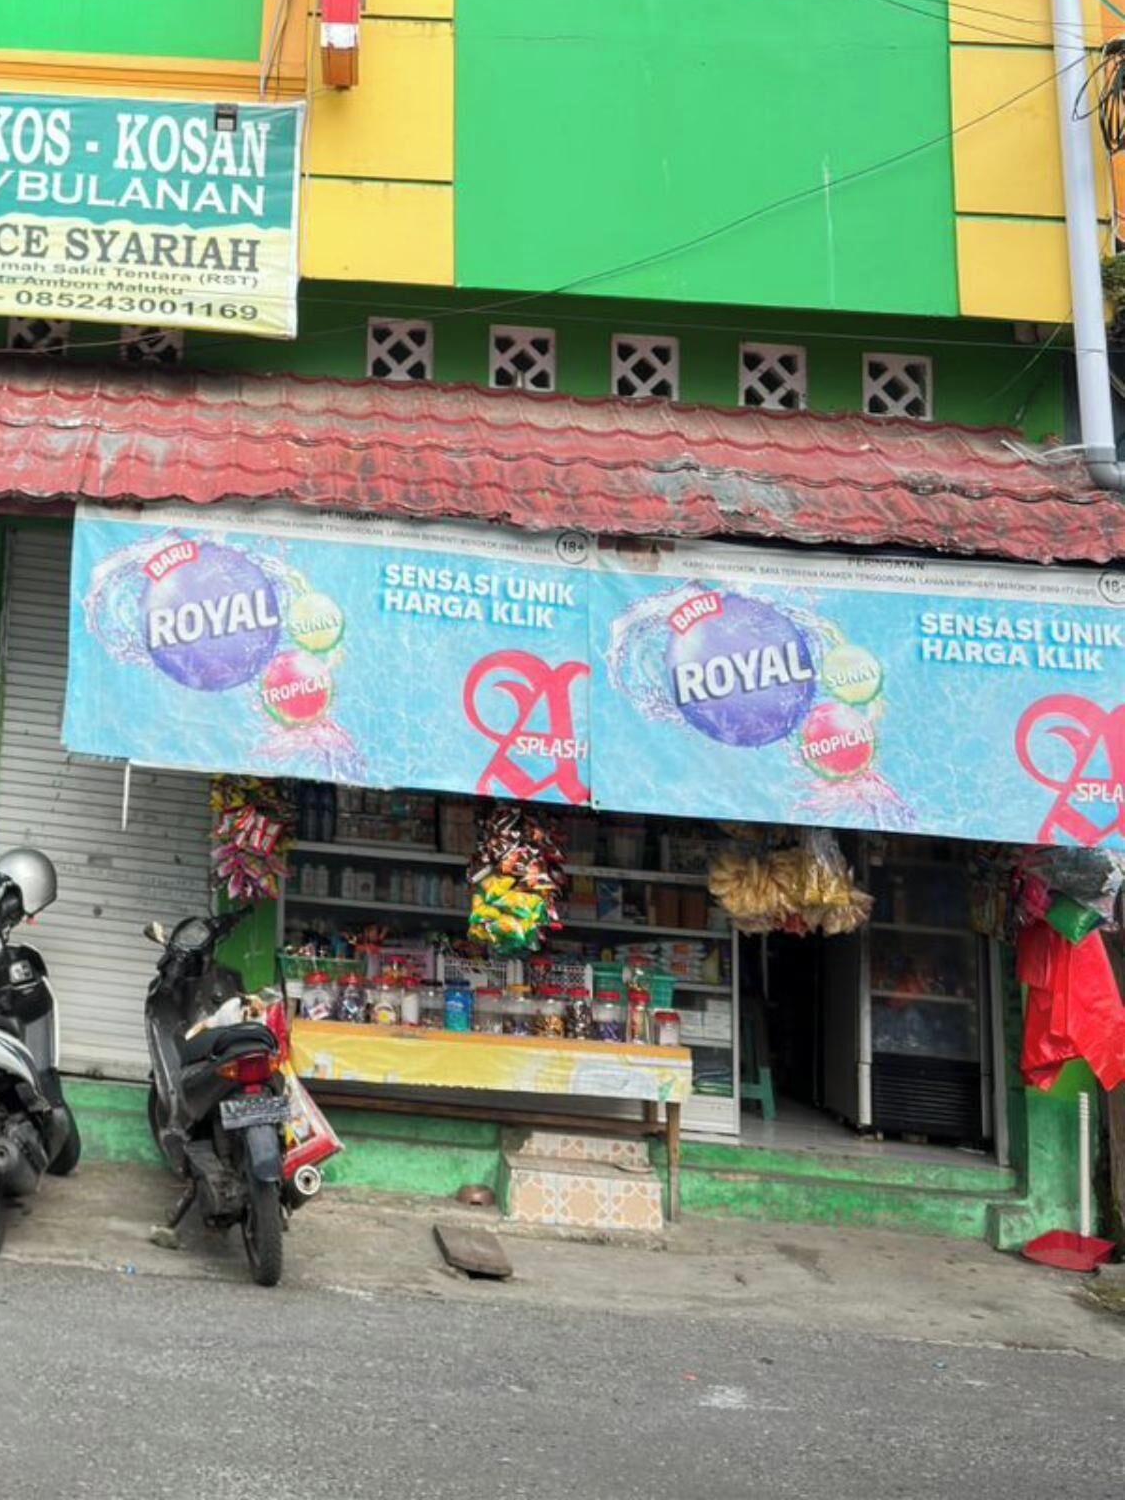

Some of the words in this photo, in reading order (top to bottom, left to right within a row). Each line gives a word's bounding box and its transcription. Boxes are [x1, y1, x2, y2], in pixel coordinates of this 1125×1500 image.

[85, 141, 99, 152] -
[113, 112, 270, 178] KOSAN
[65, 227, 262, 273] SYARIAH
[23, 274, 102, 291] Ambon
[107, 280, 185, 296] Maluku
[53, 262, 106, 277] Sakit
[112, 266, 192, 283] Tentara
[198, 273, 259, 289] (RST)
[14, 289, 259, 322] 085243001169
[148, 542, 194, 577] BARU
[562, 540, 585, 554] 18+
[385, 563, 500, 597] SENSASI
[507, 577, 576, 607] UNIK
[148, 589, 279, 649] ROYAL
[291, 613, 341, 636] SUNNY
[384, 590, 483, 622] HARGA
[492, 602, 555, 629] KLIK
[671, 596, 718, 631] BARU
[921, 612, 1042, 642] SENSASI
[1052, 620, 1125, 646] UNIK
[921, 638, 1030, 666] HARGA
[1039, 646, 1104, 671] KLIK
[260, 673, 332, 705] TROPICAL
[676, 642, 813, 704] ROYAL
[516, 735, 588, 759] SPLASH
[800, 724, 875, 760] TROPICAL
